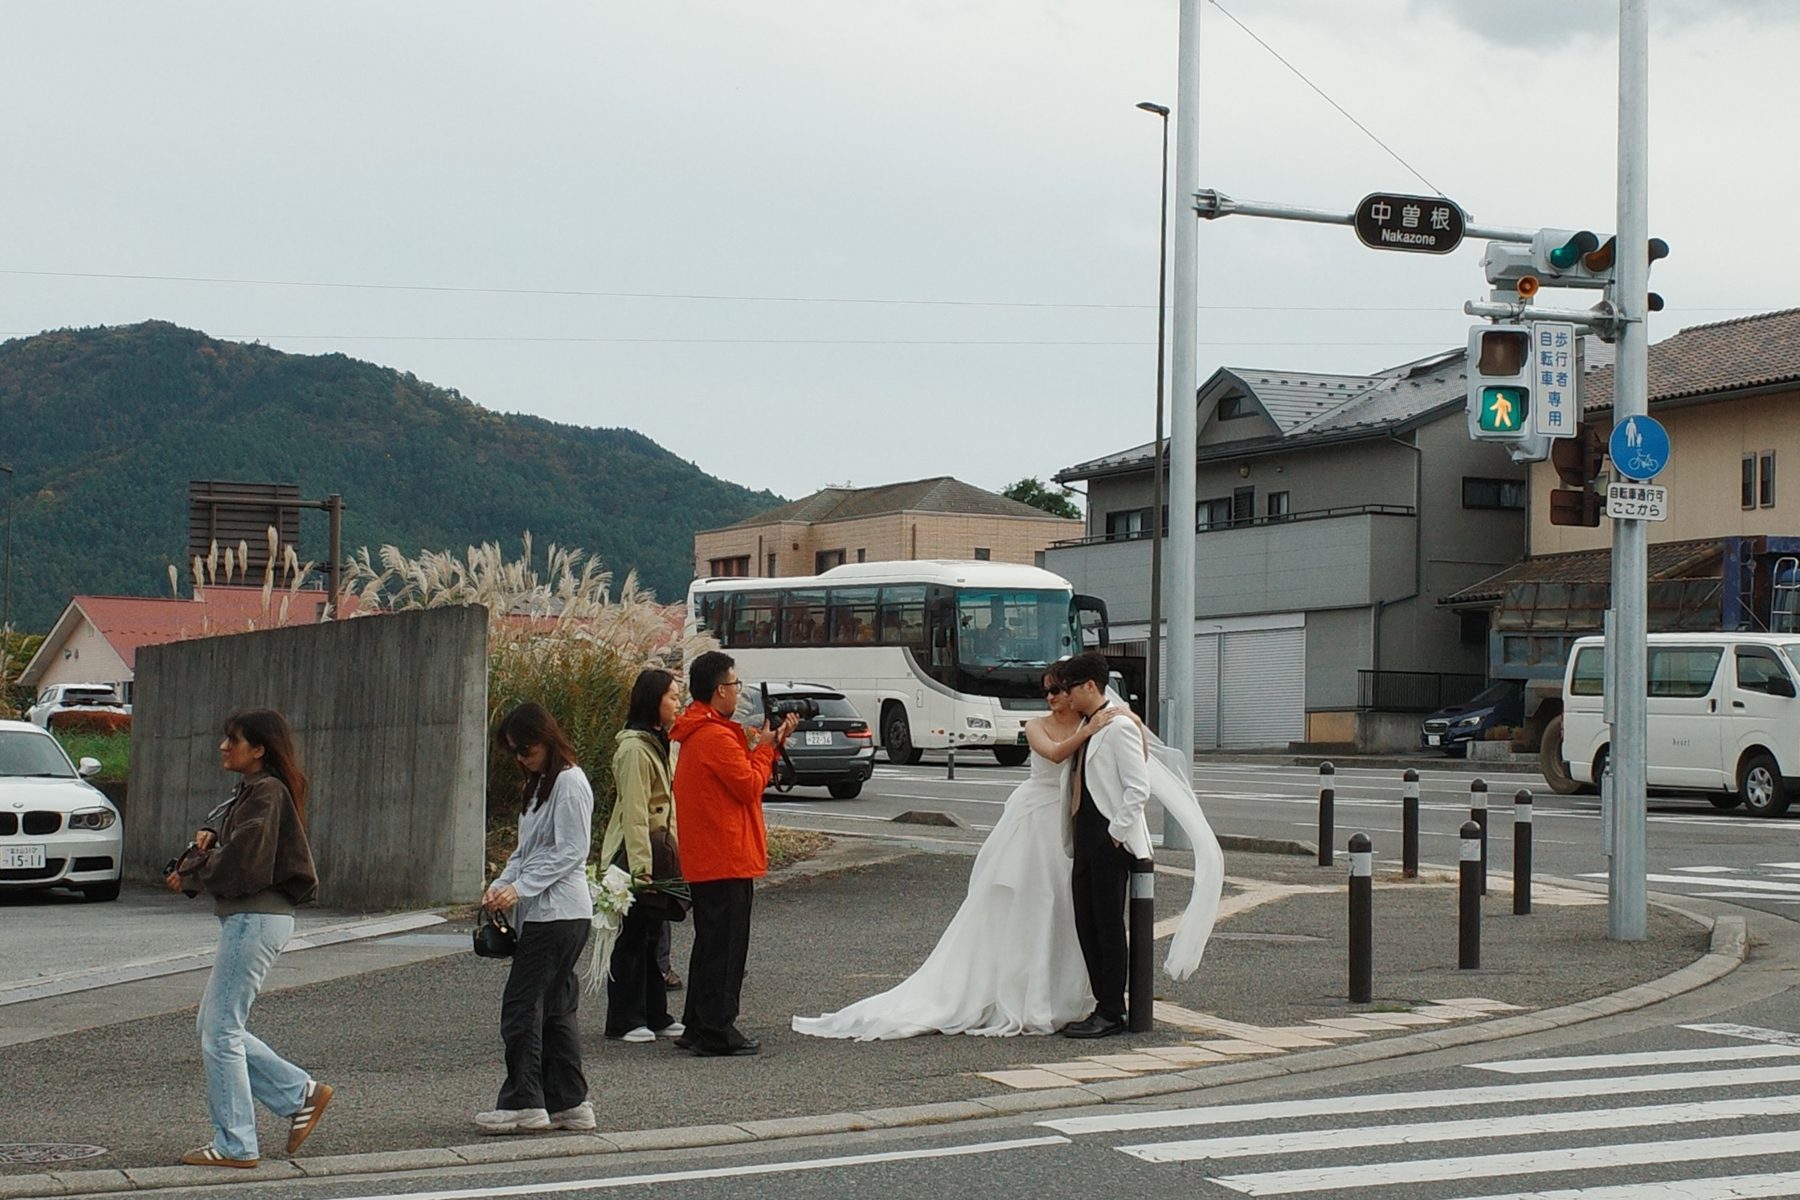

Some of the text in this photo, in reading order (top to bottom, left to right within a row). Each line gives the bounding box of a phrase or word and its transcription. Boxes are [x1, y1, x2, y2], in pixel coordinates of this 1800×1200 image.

[1371, 201, 1450, 231] 中曽根
[1381, 228, 1436, 245] Nakazone
[1540, 331, 1553, 385] 自転車
[1555, 331, 1568, 387] 歩行者
[1548, 391, 1561, 427] 専用
[1610, 486, 1664, 503] 自転車通行可
[1613, 502, 1660, 517] ここから
[11, 854, 41, 867] 15-11
